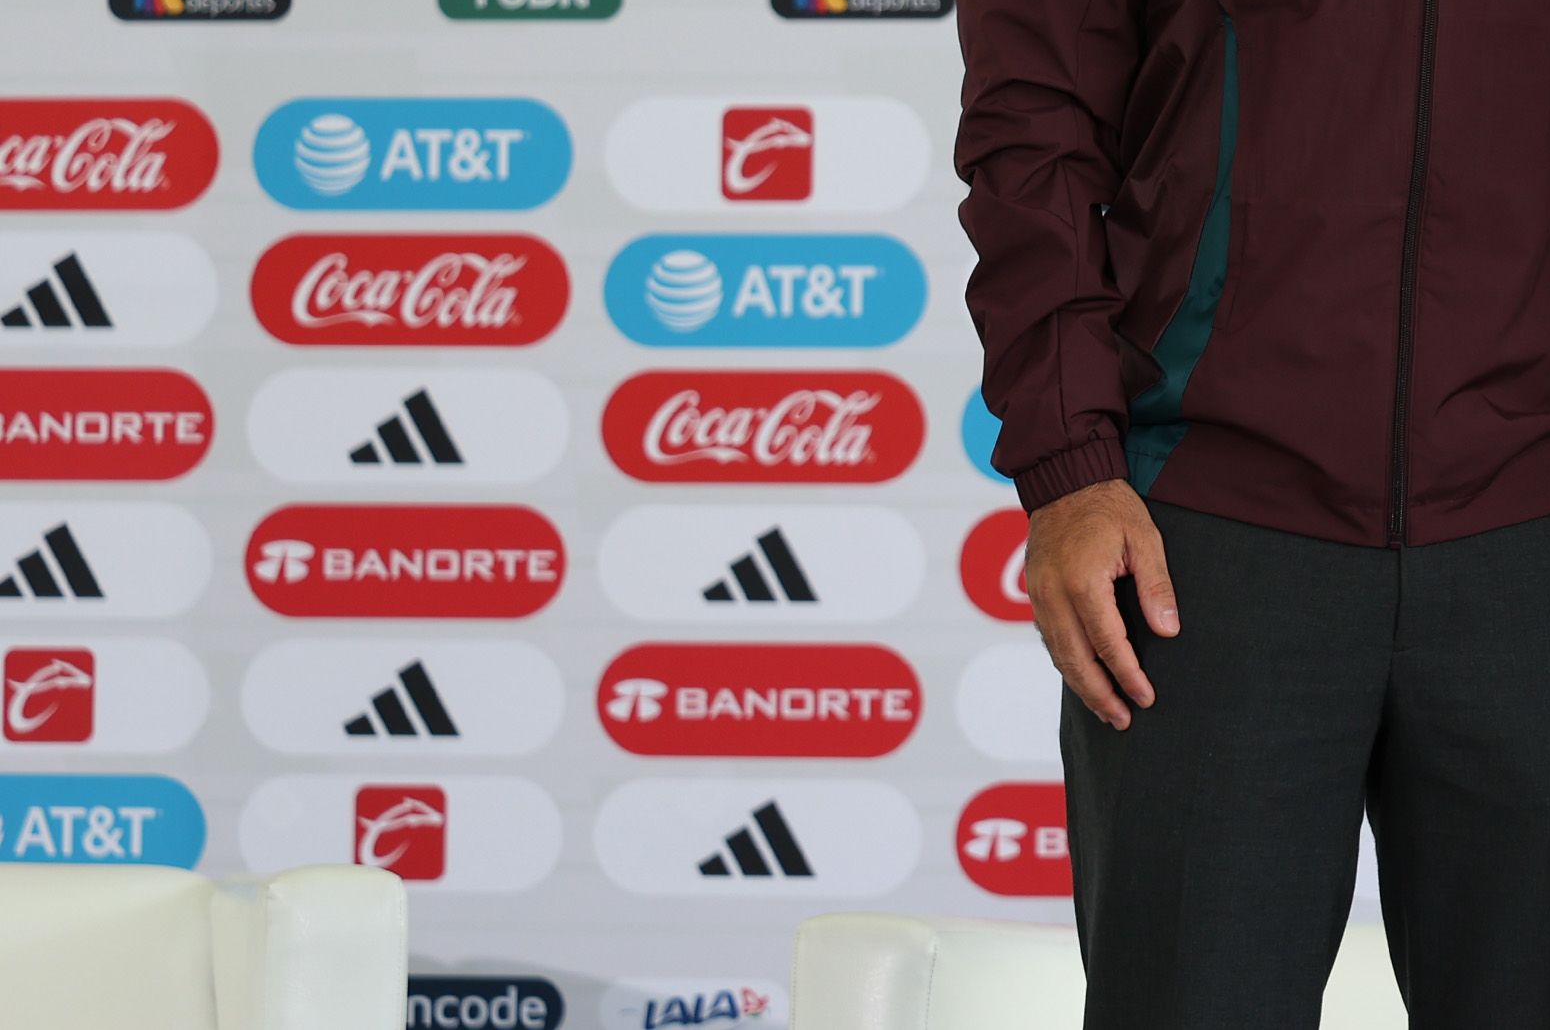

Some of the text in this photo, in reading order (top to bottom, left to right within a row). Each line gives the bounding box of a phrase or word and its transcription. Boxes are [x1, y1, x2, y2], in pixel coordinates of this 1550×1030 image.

[0, 118, 177, 193] ca-Cola
[380, 129, 520, 181] AT&T
[291, 252, 527, 328] Coca-Cola
[732, 265, 876, 318] AT&T
[0, 412, 204, 444] ANORTE
[644, 390, 880, 465] Coca-Cola
[323, 550, 557, 580] BANORTE
[676, 689, 912, 720] BANORTE
[14, 806, 156, 856] AT&T
[407, 986, 547, 1028] ncode
[645, 990, 739, 1030] LALA
